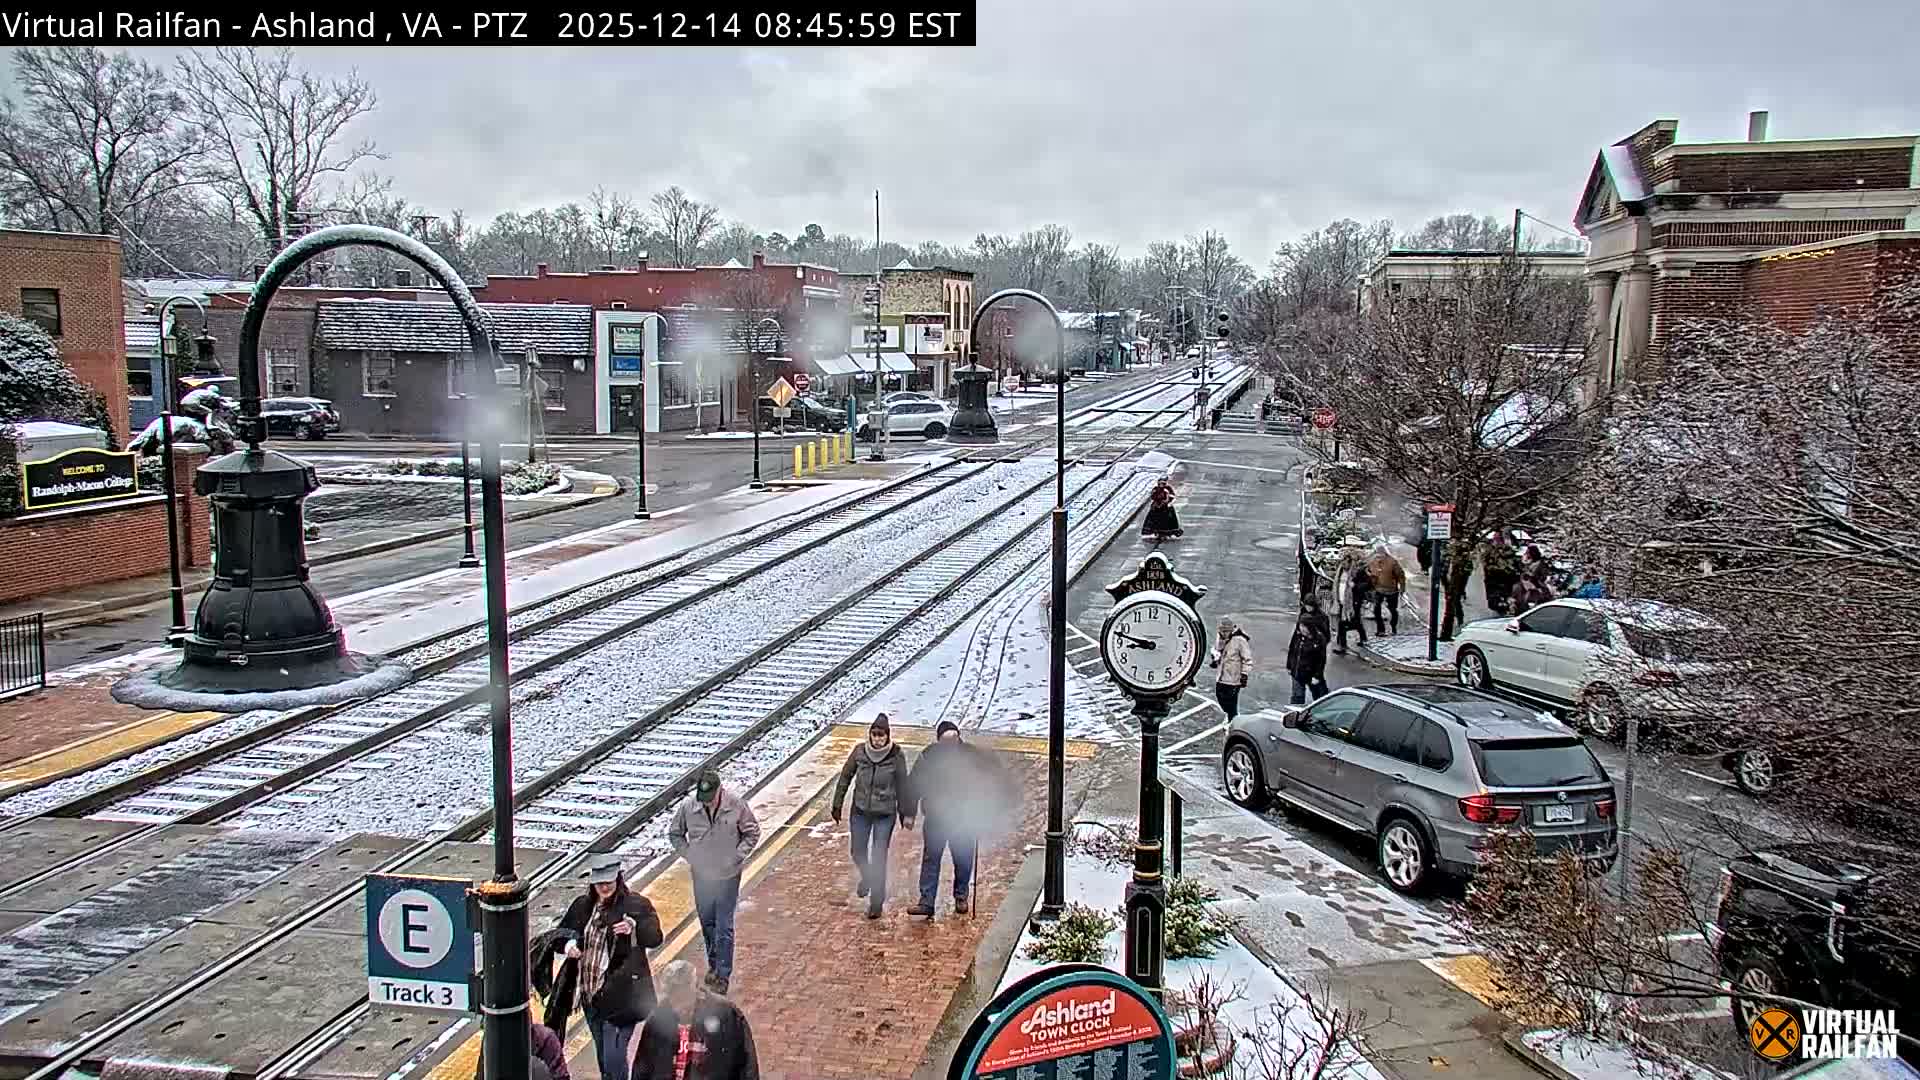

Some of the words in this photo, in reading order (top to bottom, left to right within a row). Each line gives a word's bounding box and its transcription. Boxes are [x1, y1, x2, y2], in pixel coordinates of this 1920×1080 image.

[63, 464, 96, 475] WELCOME
[96, 464, 105, 473] TO
[32, 481, 104, 497] Randolph-Macon
[104, 475, 134, 488] College
[1128, 580, 1183, 597] ASHLAND
[1133, 611, 1142, 623] 11
[1148, 607, 1159, 620] 12
[1121, 623, 1130, 634] 10
[1177, 626, 1185, 638] 2
[1116, 637, 1123, 649] 9
[1182, 641, 1188, 653] 3
[1120, 652, 1128, 664] 8
[1176, 655, 1183, 665] 4
[1131, 666, 1138, 678] 7
[1147, 671, 1155, 682] 6
[1164, 667, 1172, 679] 5
[402, 903, 430, 954] E
[381, 982, 435, 1004] Track
[442, 987, 453, 1006] 3
[1020, 990, 1116, 1034] Ashland
[1030, 1026, 1068, 1043] TOWN
[1070, 1016, 1111, 1036] CLOCK
